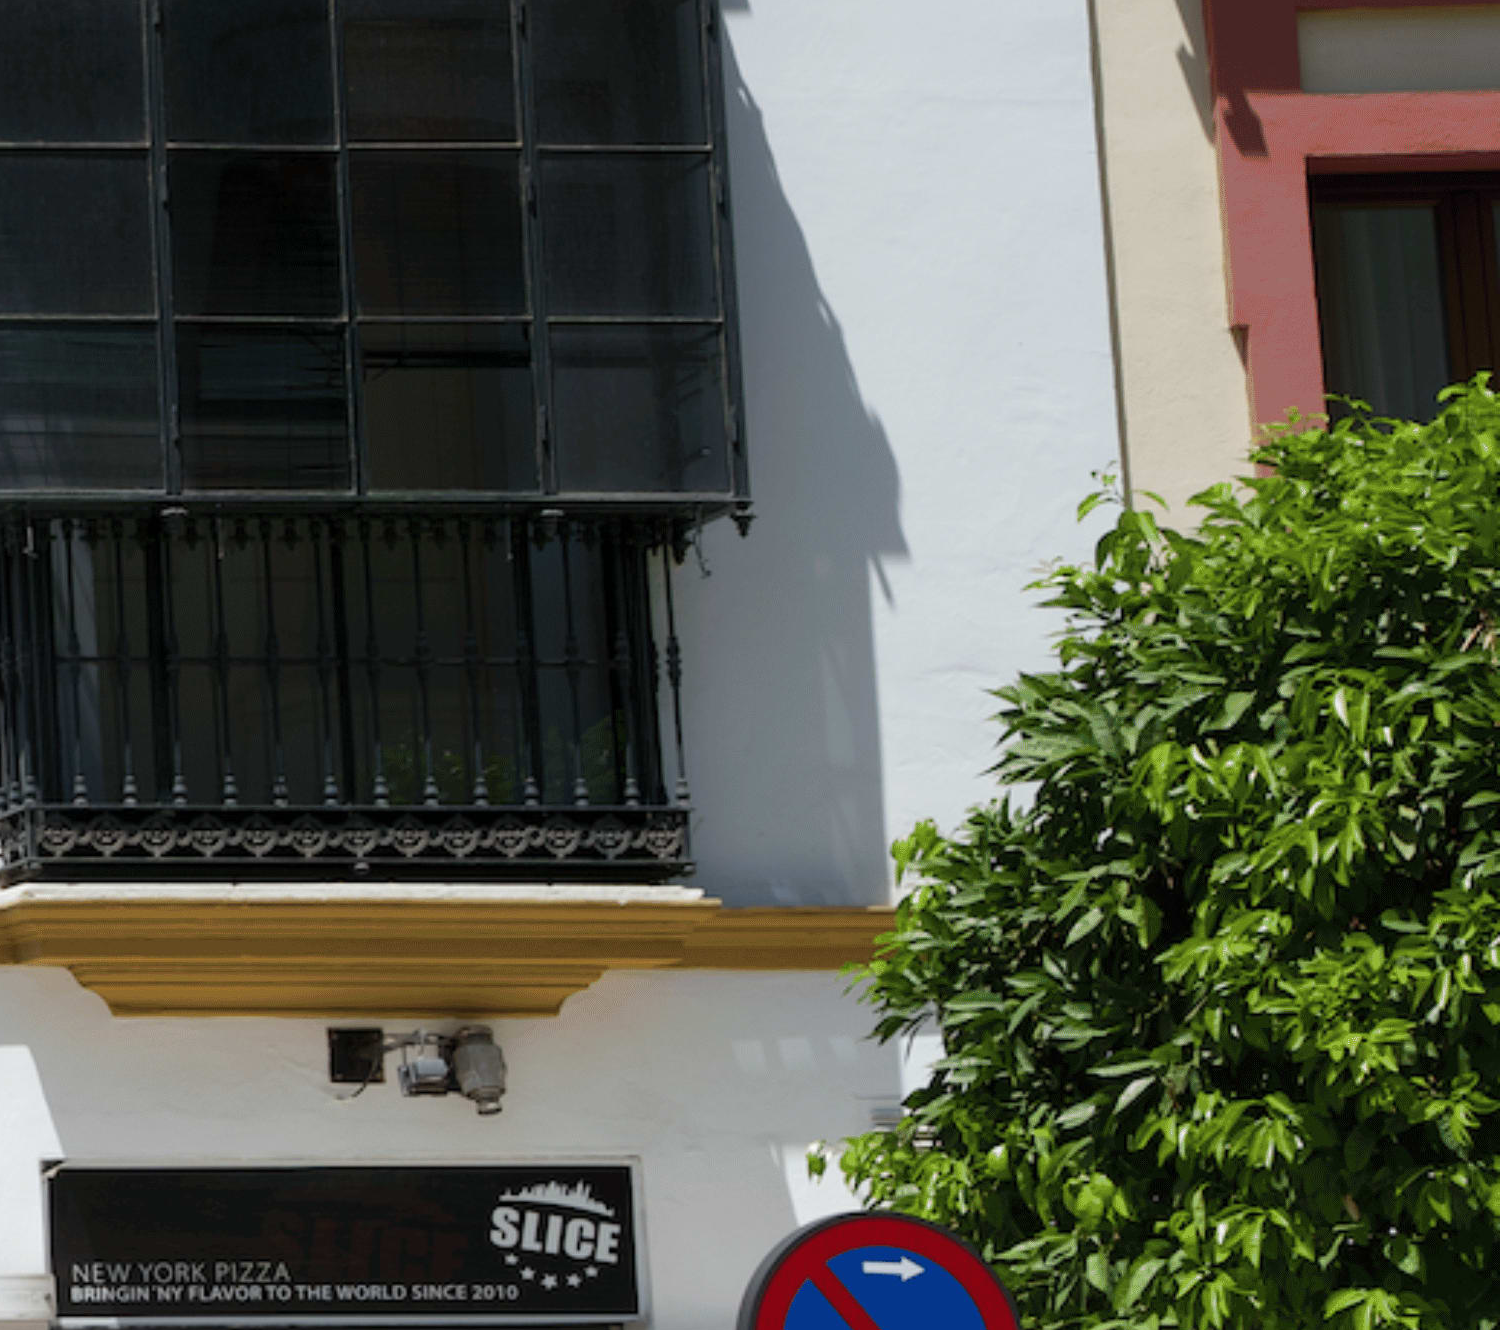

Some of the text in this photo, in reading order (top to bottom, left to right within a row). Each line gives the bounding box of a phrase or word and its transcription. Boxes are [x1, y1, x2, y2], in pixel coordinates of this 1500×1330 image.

[487, 1204, 621, 1265] SLICE
[72, 1261, 292, 1284] NEW YORK PIZZA
[188, 1284, 263, 1301] FLAVOR
[265, 1284, 292, 1301] TO
[295, 1284, 333, 1301] THE
[336, 1283, 407, 1301] WORLD
[411, 1283, 467, 1300] SINCE
[471, 1283, 519, 1300] 2010
